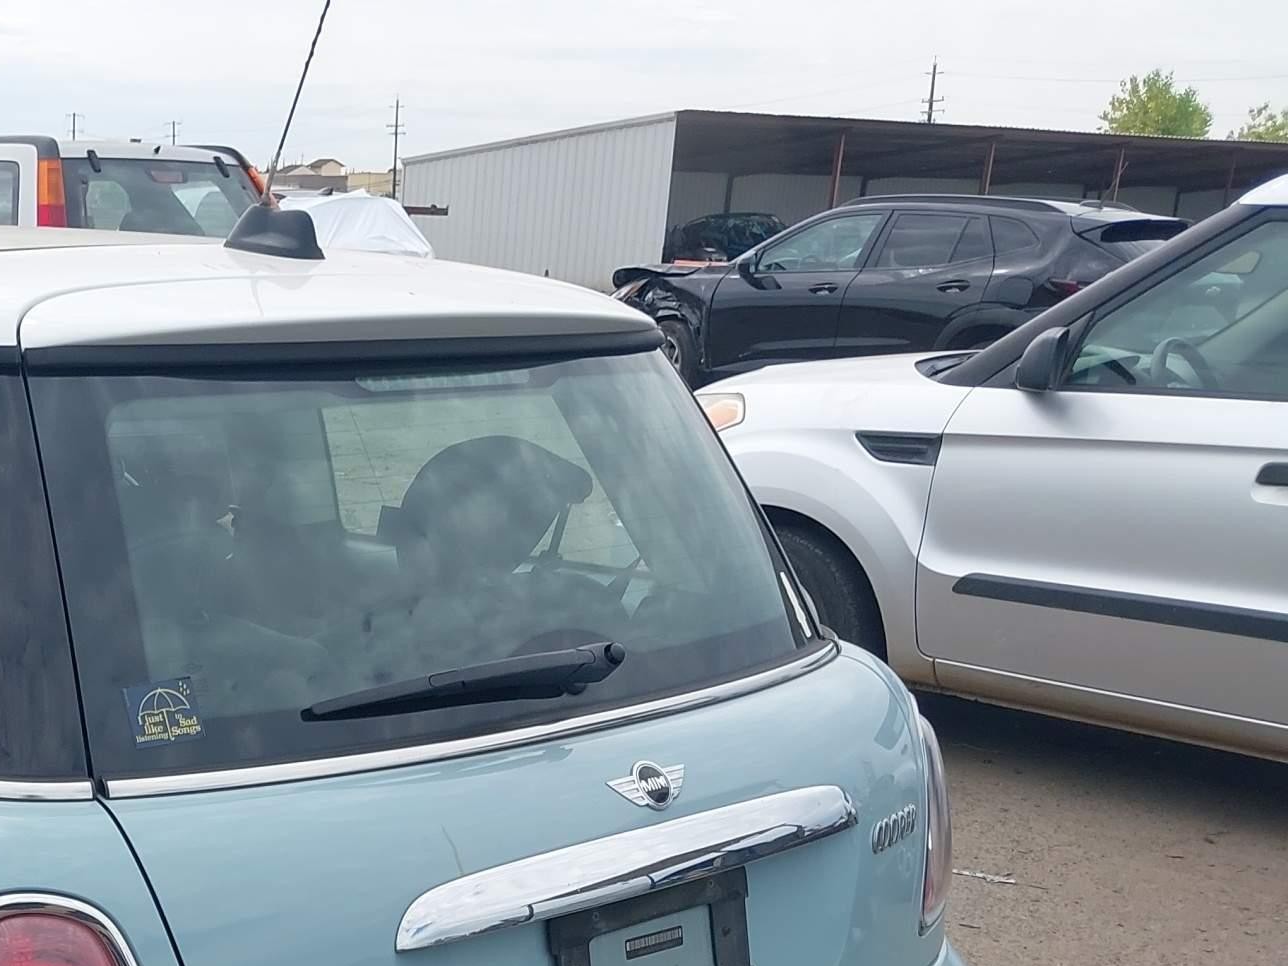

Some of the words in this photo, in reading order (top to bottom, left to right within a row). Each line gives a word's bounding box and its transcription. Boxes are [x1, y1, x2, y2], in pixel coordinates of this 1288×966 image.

[179, 715, 197, 727] Sad
[171, 725, 201, 735] Songs
[640, 775, 668, 792] MINI
[872, 804, 916, 854] COOPER
